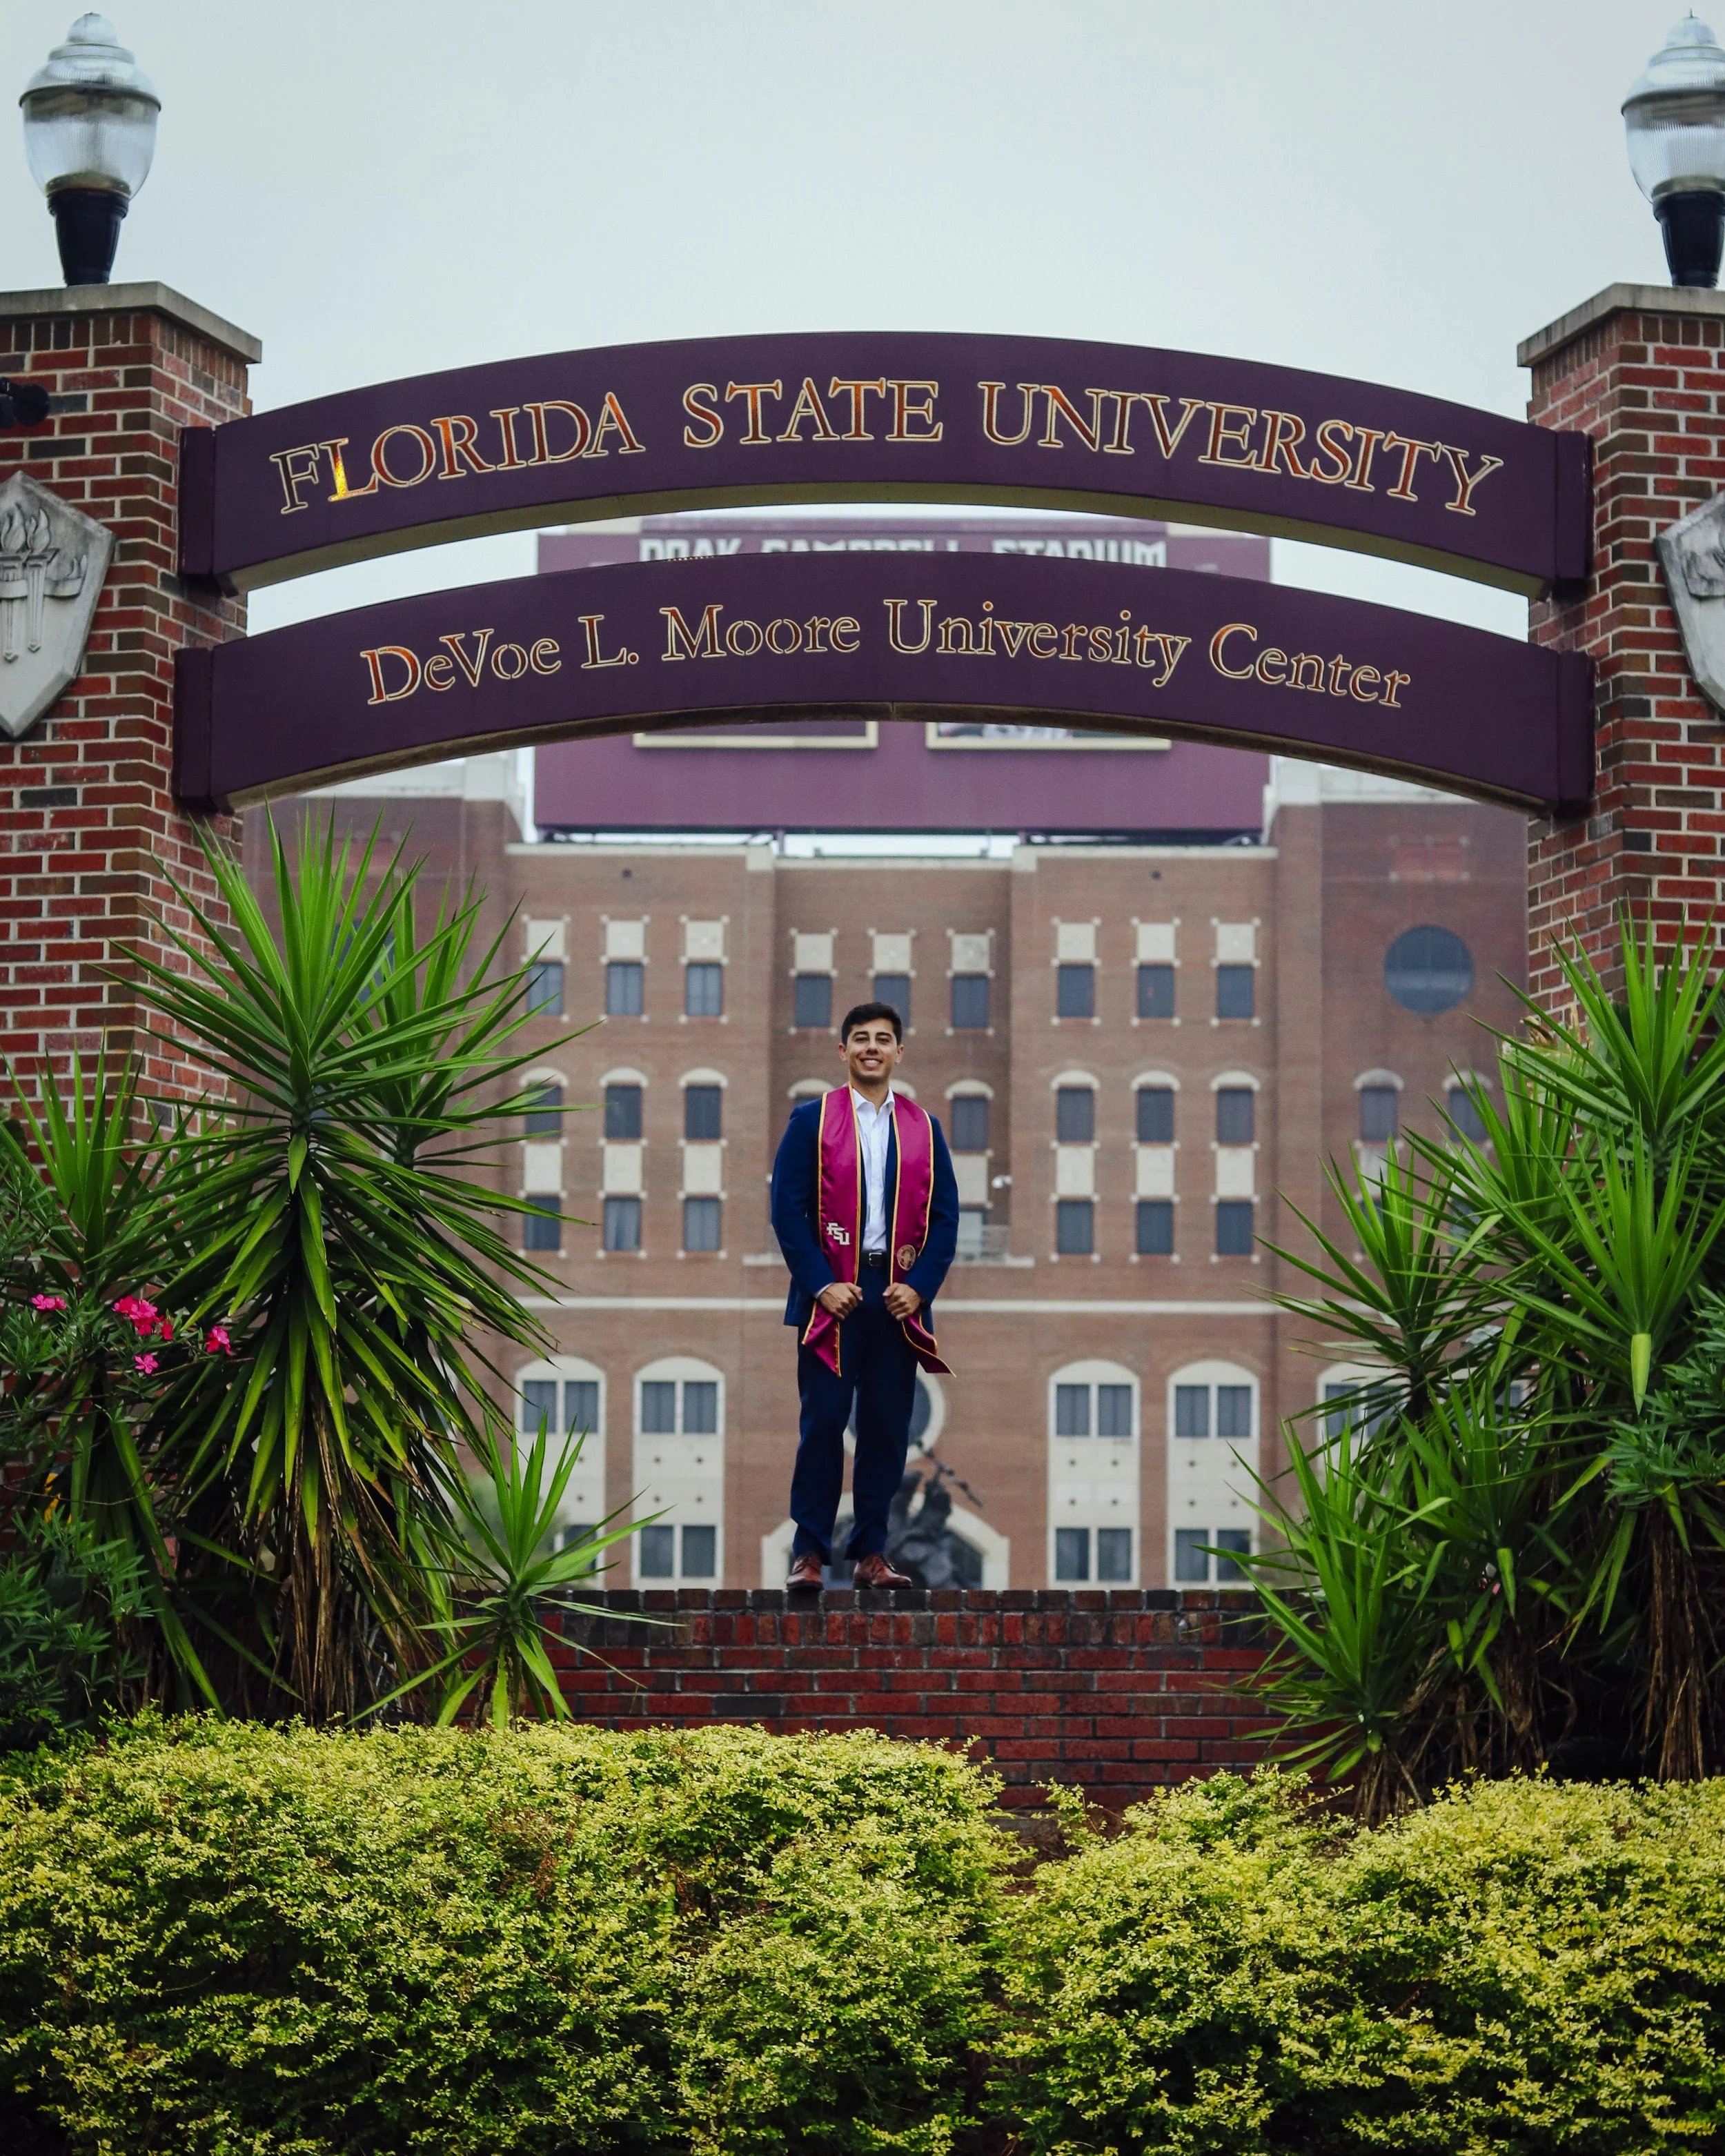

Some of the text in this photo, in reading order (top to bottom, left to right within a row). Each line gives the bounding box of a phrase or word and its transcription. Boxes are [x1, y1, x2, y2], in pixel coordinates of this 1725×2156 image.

[270, 377, 1504, 516] FLORIDA STATE UNIVERSITY
[360, 599, 1411, 708] DeVoe L. Moore University Center
[826, 1222, 850, 1245] FSU
